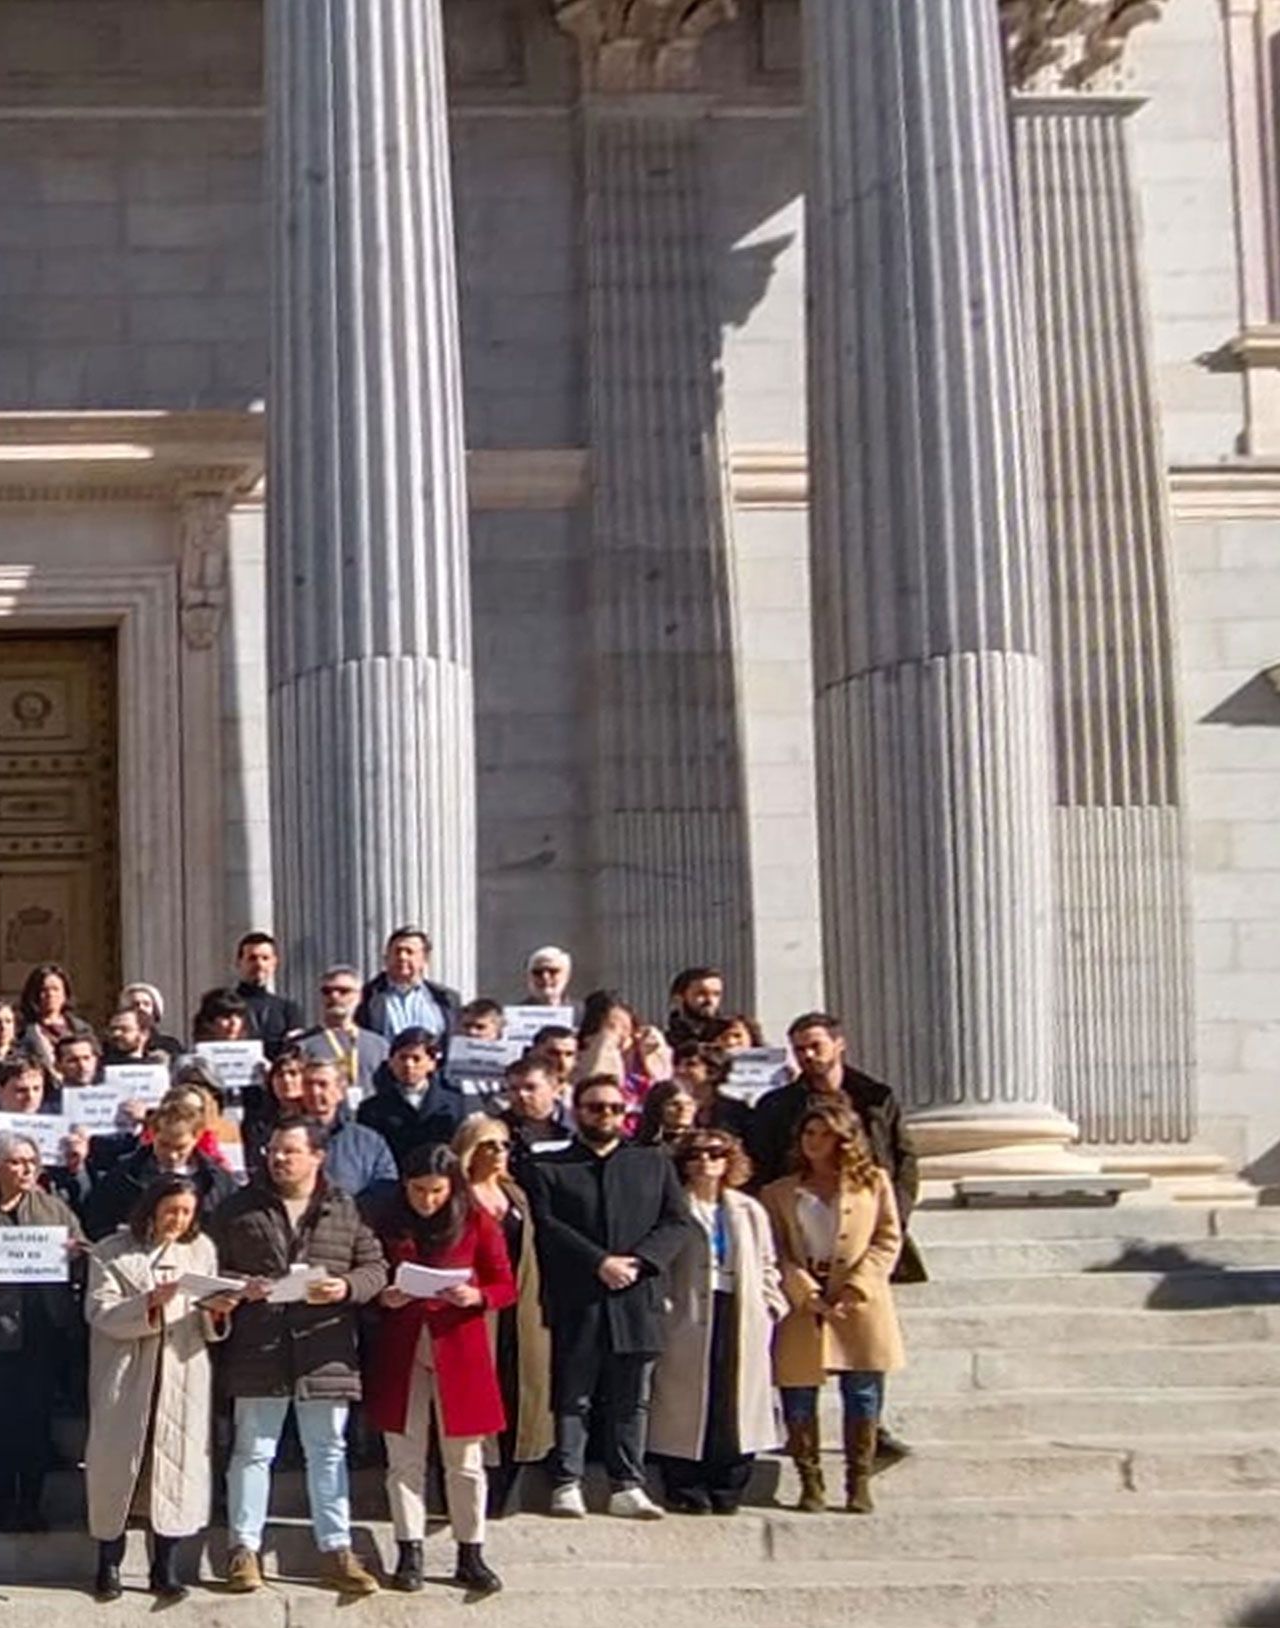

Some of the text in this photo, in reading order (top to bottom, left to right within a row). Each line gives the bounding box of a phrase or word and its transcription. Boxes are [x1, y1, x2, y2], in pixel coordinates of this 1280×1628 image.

[2, 1231, 49, 1242] Señalar
[8, 1251, 41, 1259] no es
